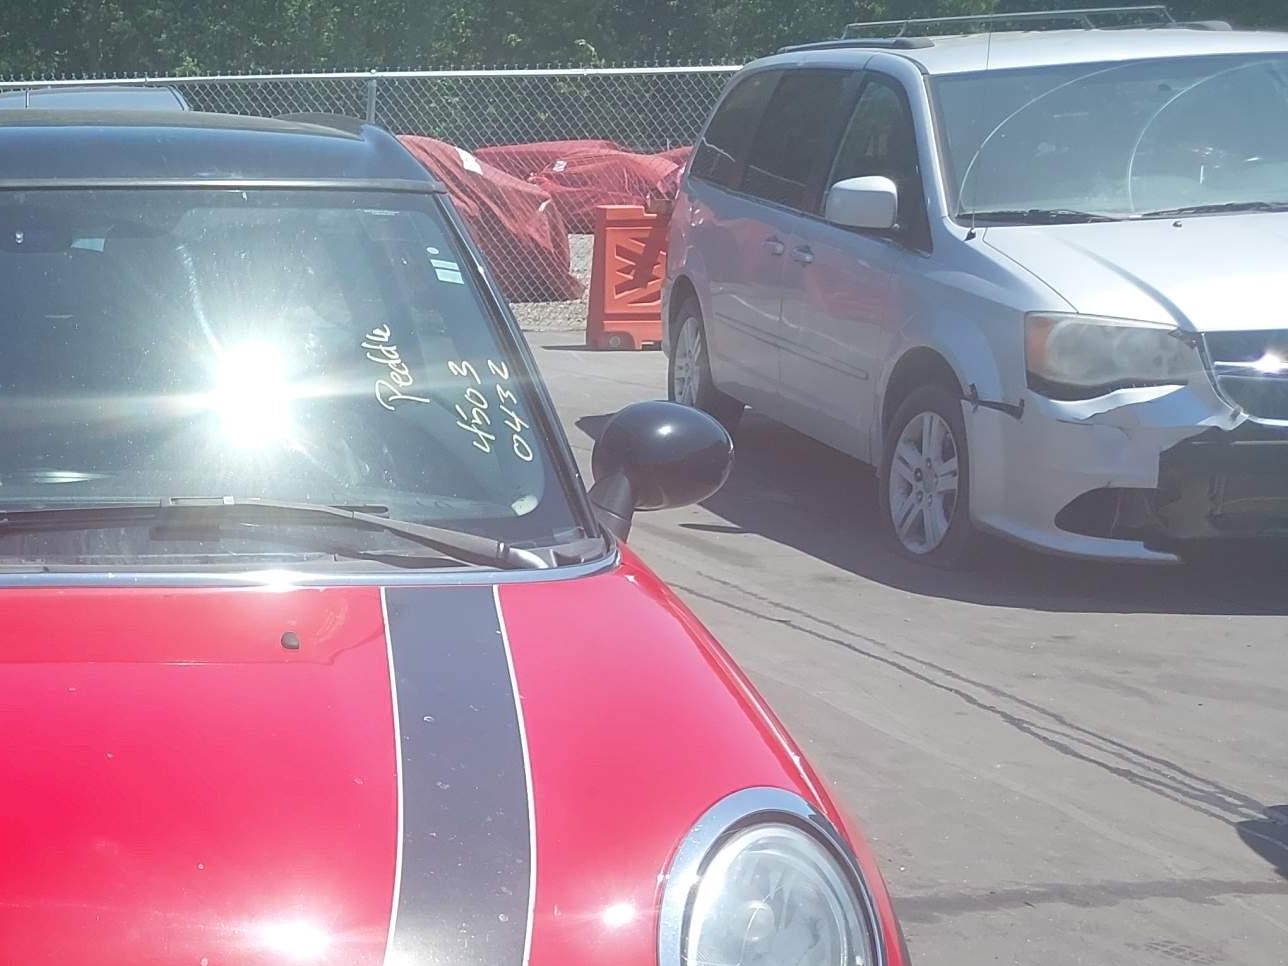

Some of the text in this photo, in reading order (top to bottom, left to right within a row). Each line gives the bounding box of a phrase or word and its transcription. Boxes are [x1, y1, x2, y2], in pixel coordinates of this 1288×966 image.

[361, 323, 431, 412] Peddle
[447, 359, 496, 454] 4503
[487, 358, 534, 463] 0432
